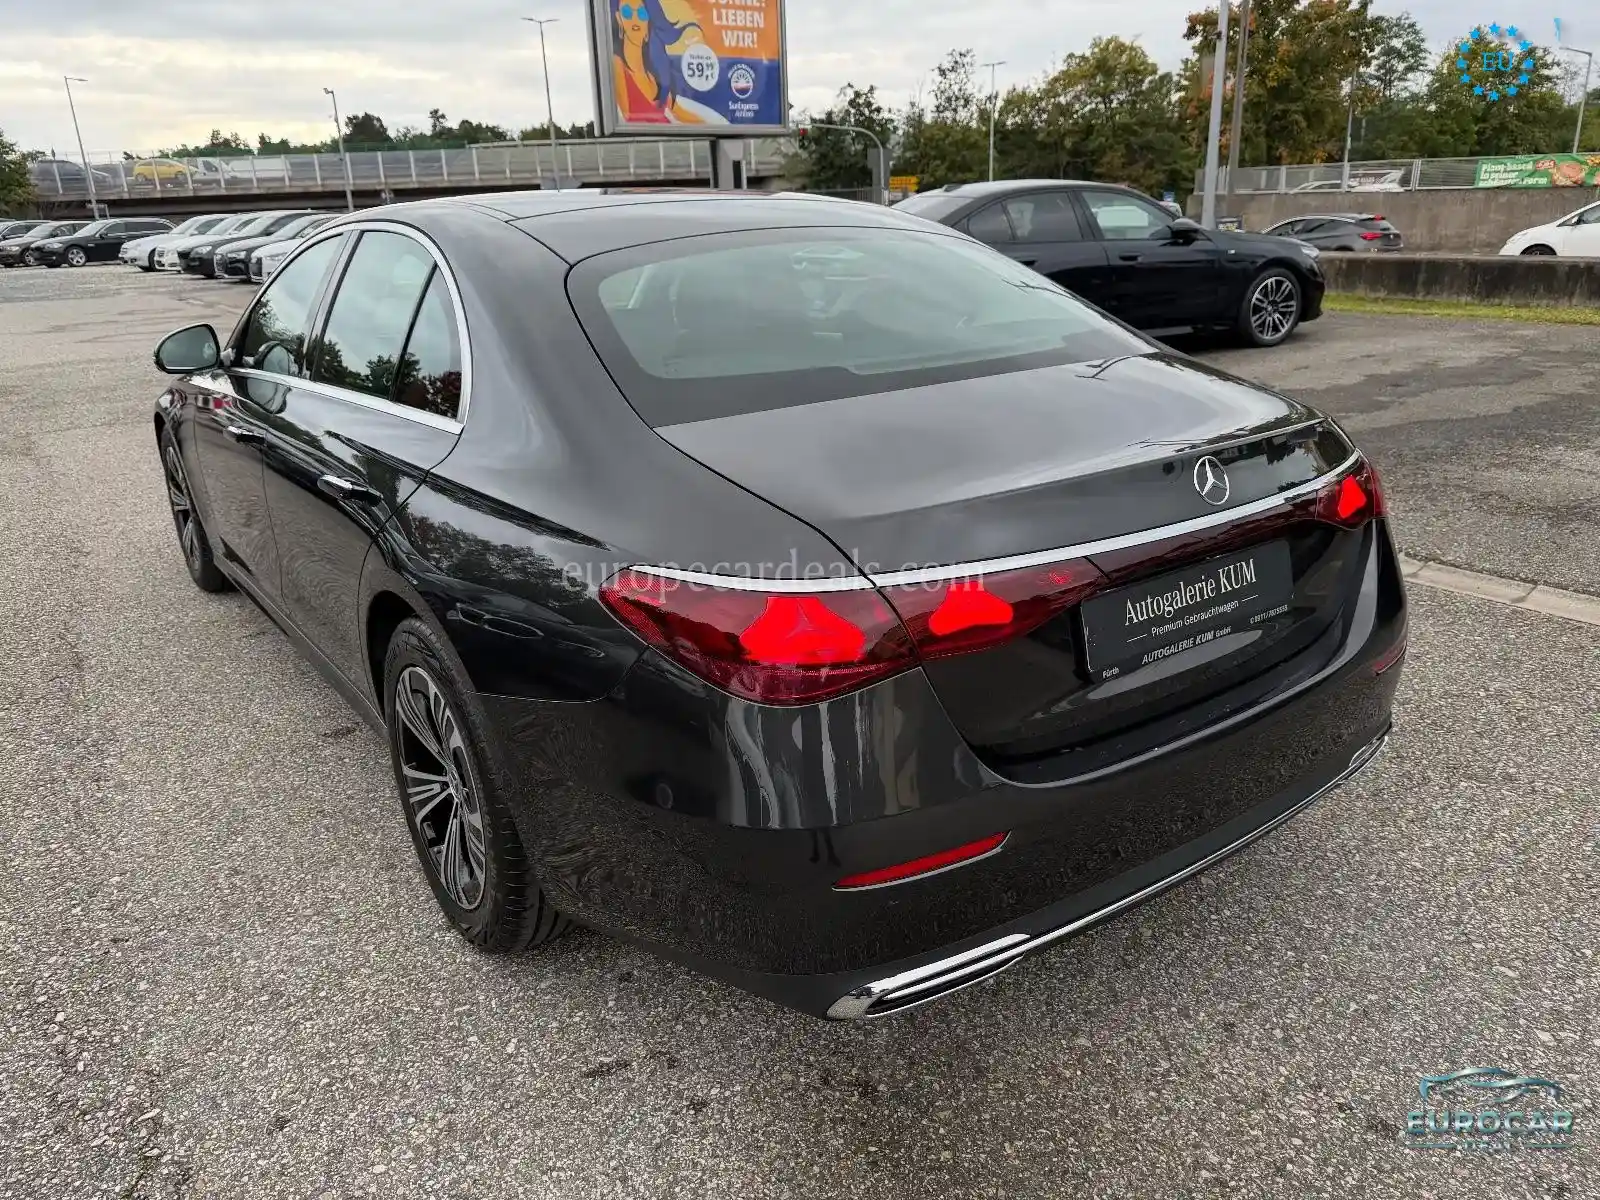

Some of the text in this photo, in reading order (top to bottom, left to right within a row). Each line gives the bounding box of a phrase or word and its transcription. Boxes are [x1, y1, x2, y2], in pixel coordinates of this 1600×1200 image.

[713, 8, 764, 28] LIEBEN
[722, 30, 758, 48] WIR!
[1124, 558, 1257, 626] Autogalerie KUM
[1151, 600, 1239, 637] Premium Gebrauchtwagen
[1102, 666, 1120, 679] Fürth
[1142, 636, 1194, 665] AUTOGALERIE
[1195, 629, 1215, 645] KUM
